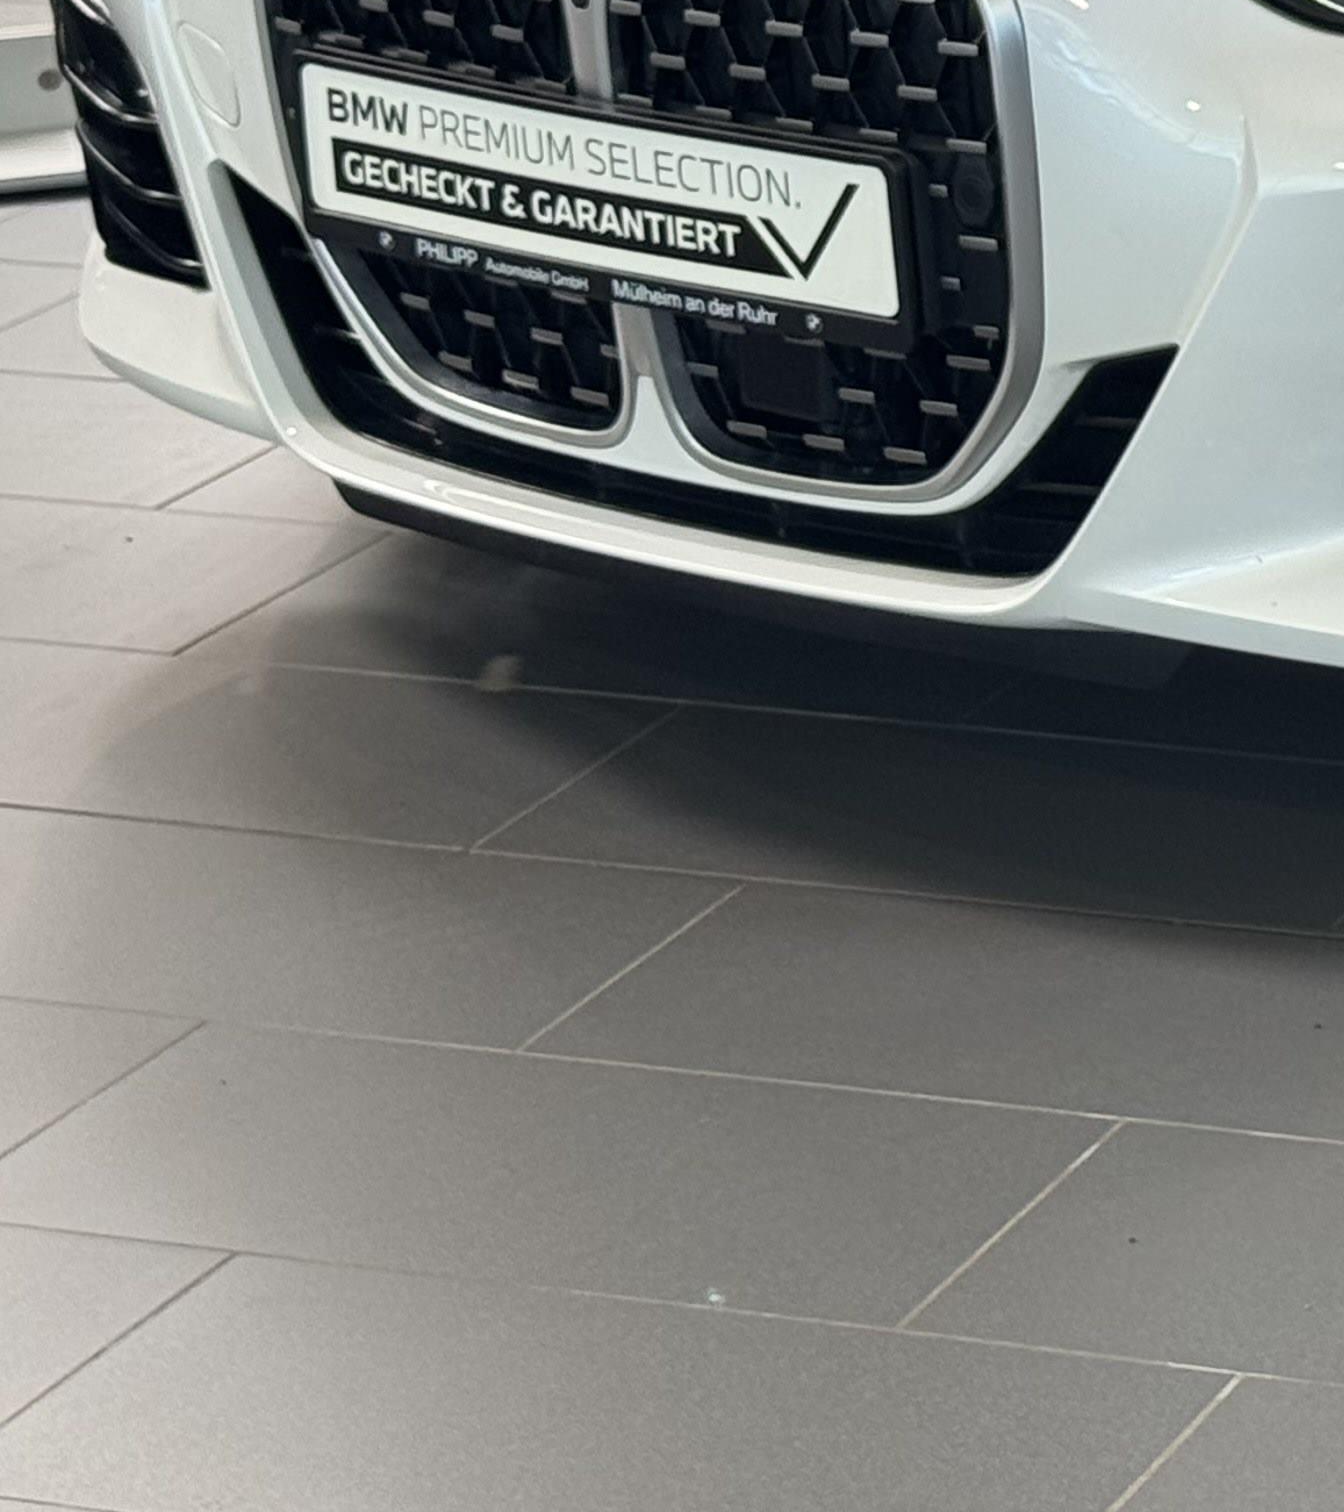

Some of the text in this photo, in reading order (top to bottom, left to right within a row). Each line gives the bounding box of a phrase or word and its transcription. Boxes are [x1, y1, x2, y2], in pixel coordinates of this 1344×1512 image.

[327, 87, 802, 210] BMW PREMIUM SELECTION.
[341, 150, 742, 258] GECHECKT & GARANTIERT
[415, 237, 779, 326] PHILIPP Automobile GmbH Mülheim an der Ruhr
